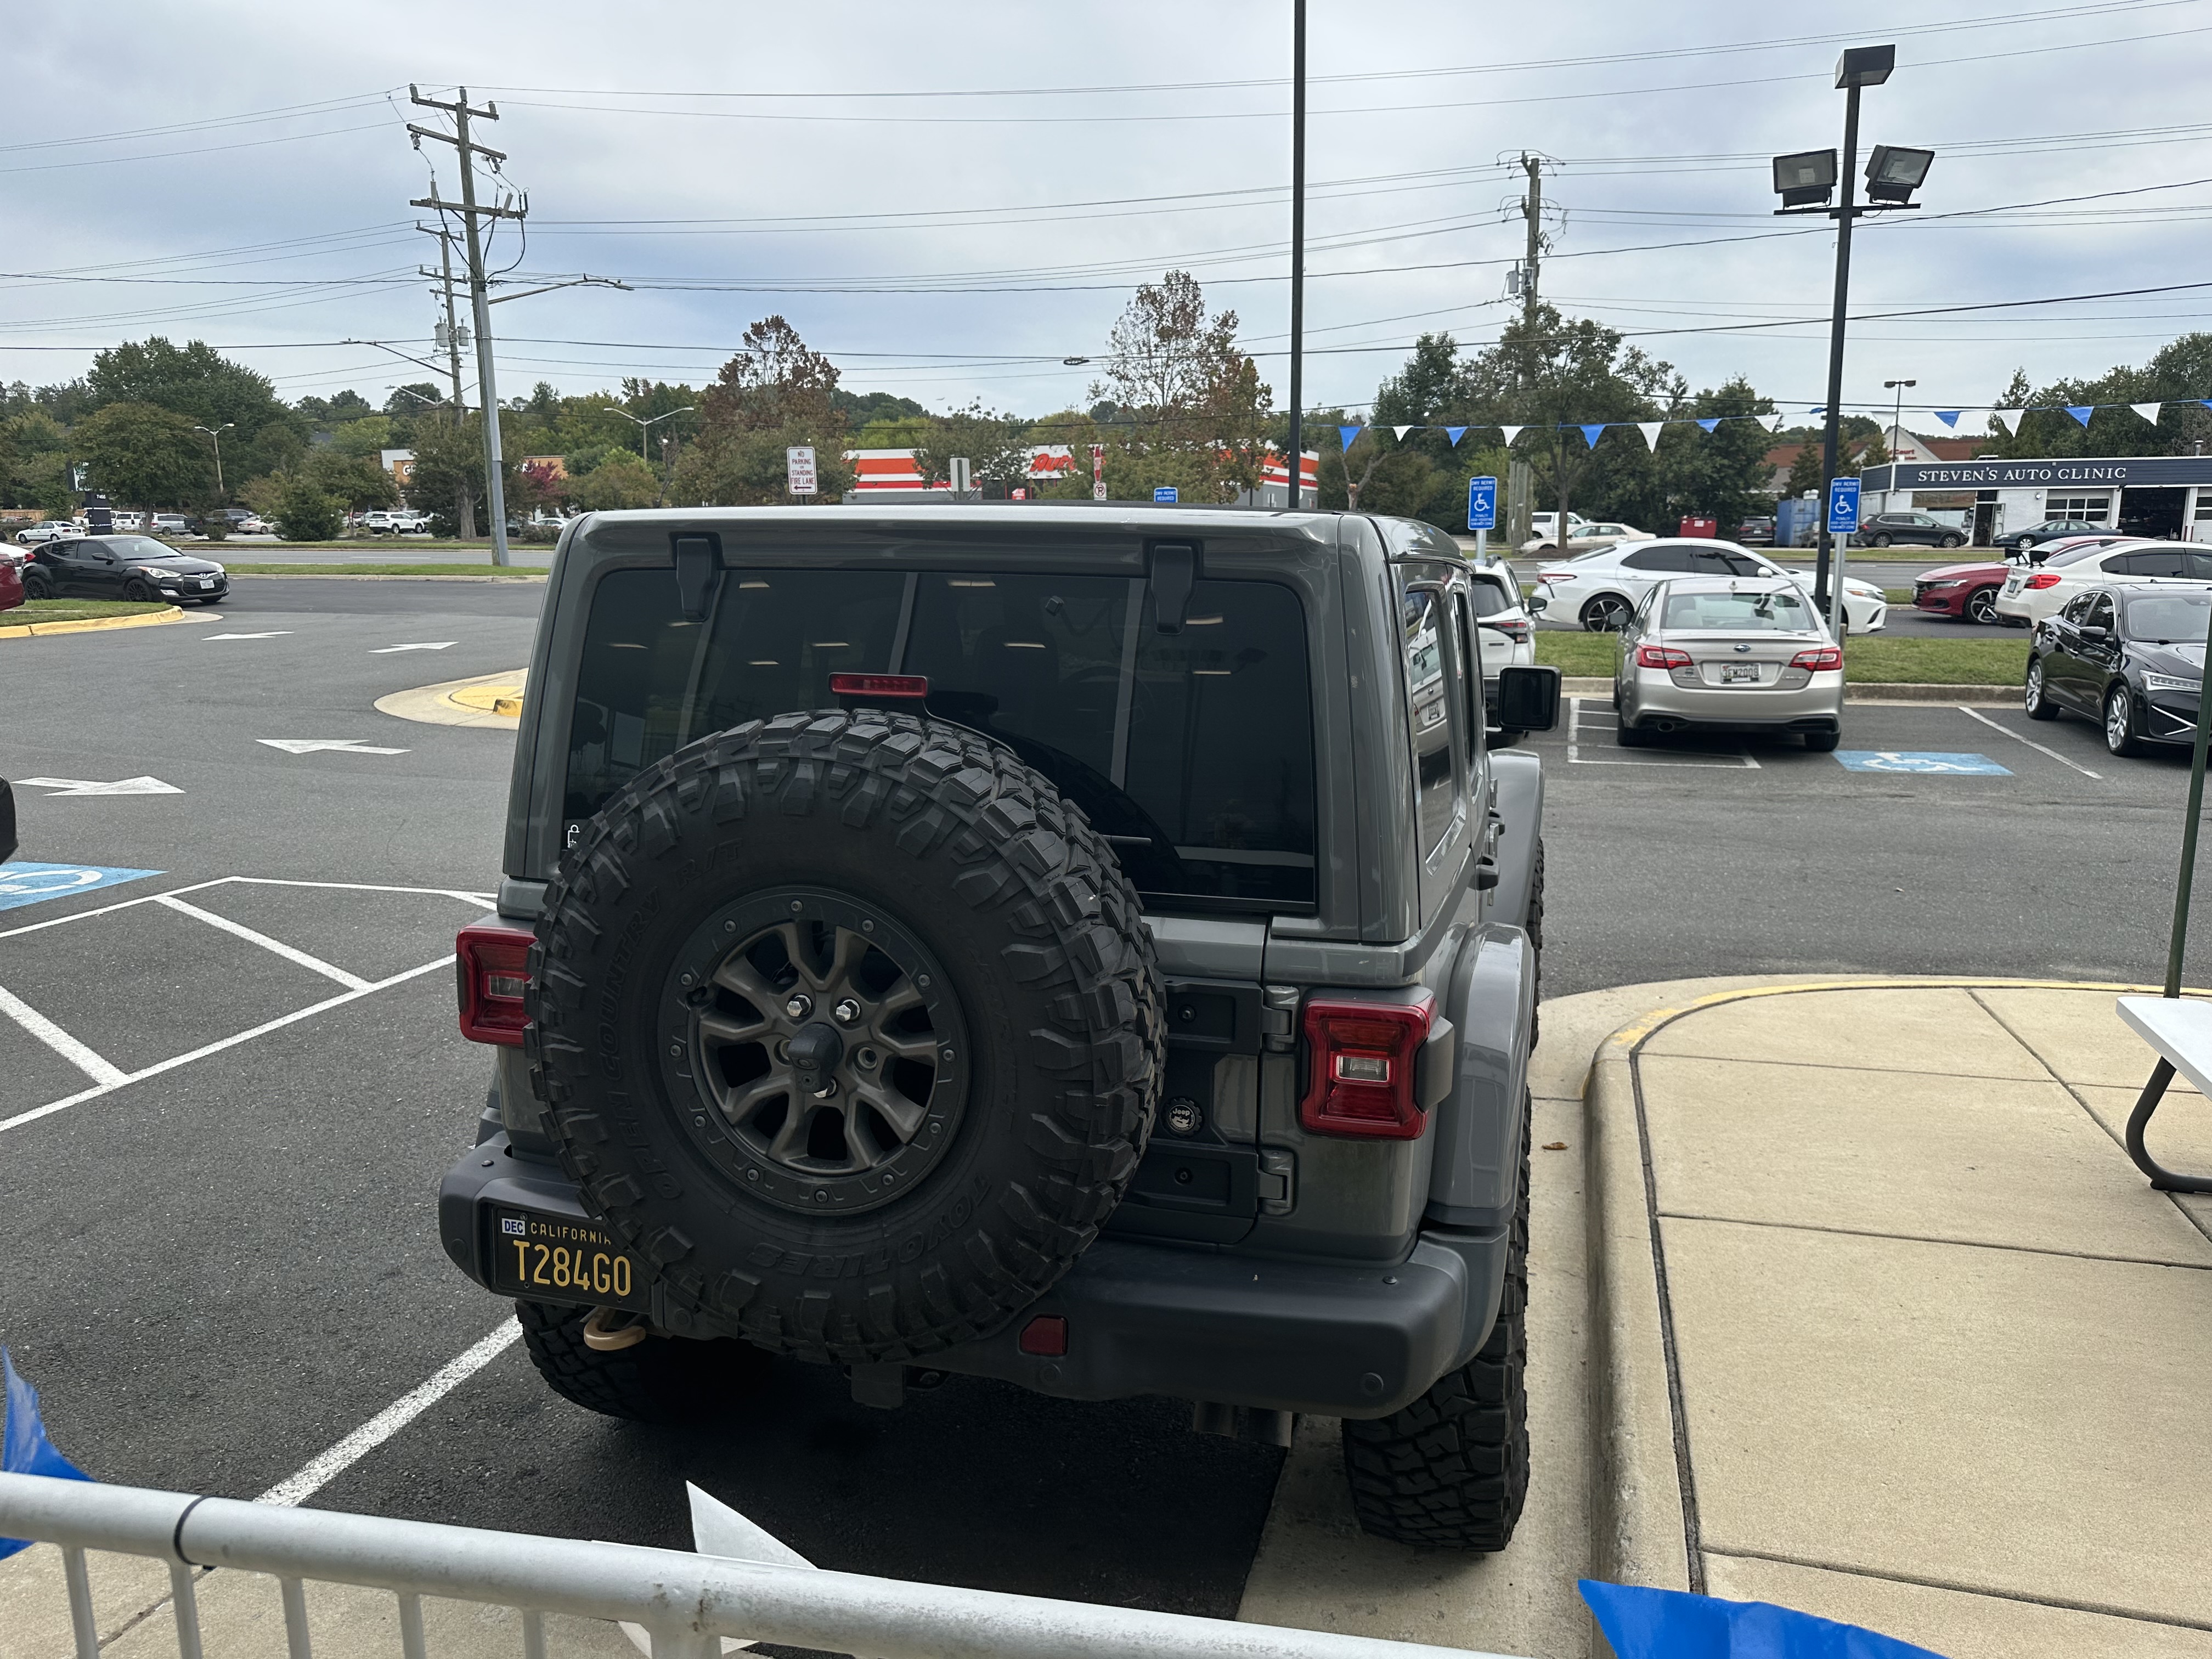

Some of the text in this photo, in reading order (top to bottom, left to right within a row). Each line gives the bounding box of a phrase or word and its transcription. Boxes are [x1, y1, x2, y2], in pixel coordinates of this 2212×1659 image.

[1917, 467, 2127, 482] STEVEN'S AUTO CLINIC
[597, 885, 661, 1081] COUNTRY
[1172, 1108, 1190, 1116] Jeep
[606, 1090, 685, 1200] OPEN
[504, 1220, 523, 1234] DEC
